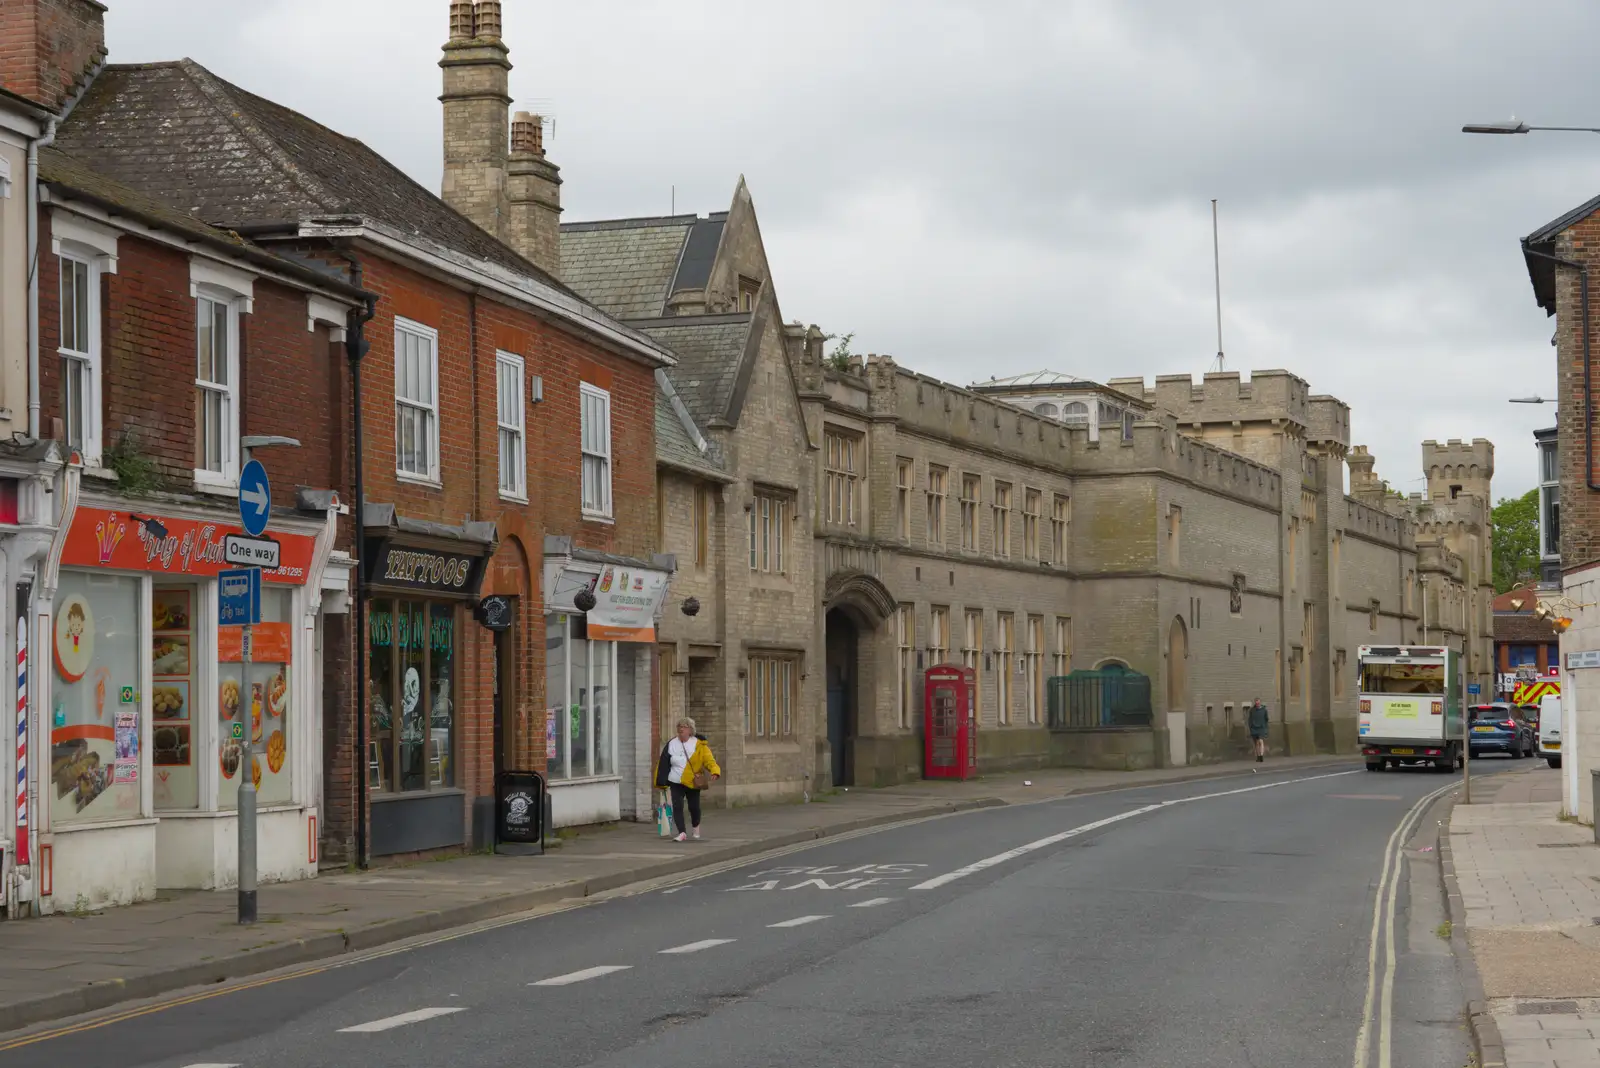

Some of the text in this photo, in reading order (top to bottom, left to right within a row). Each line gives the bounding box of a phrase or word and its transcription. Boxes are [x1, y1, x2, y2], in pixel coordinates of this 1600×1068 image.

[230, 542, 275, 562] One way
[384, 549, 470, 587] TATTOOS
